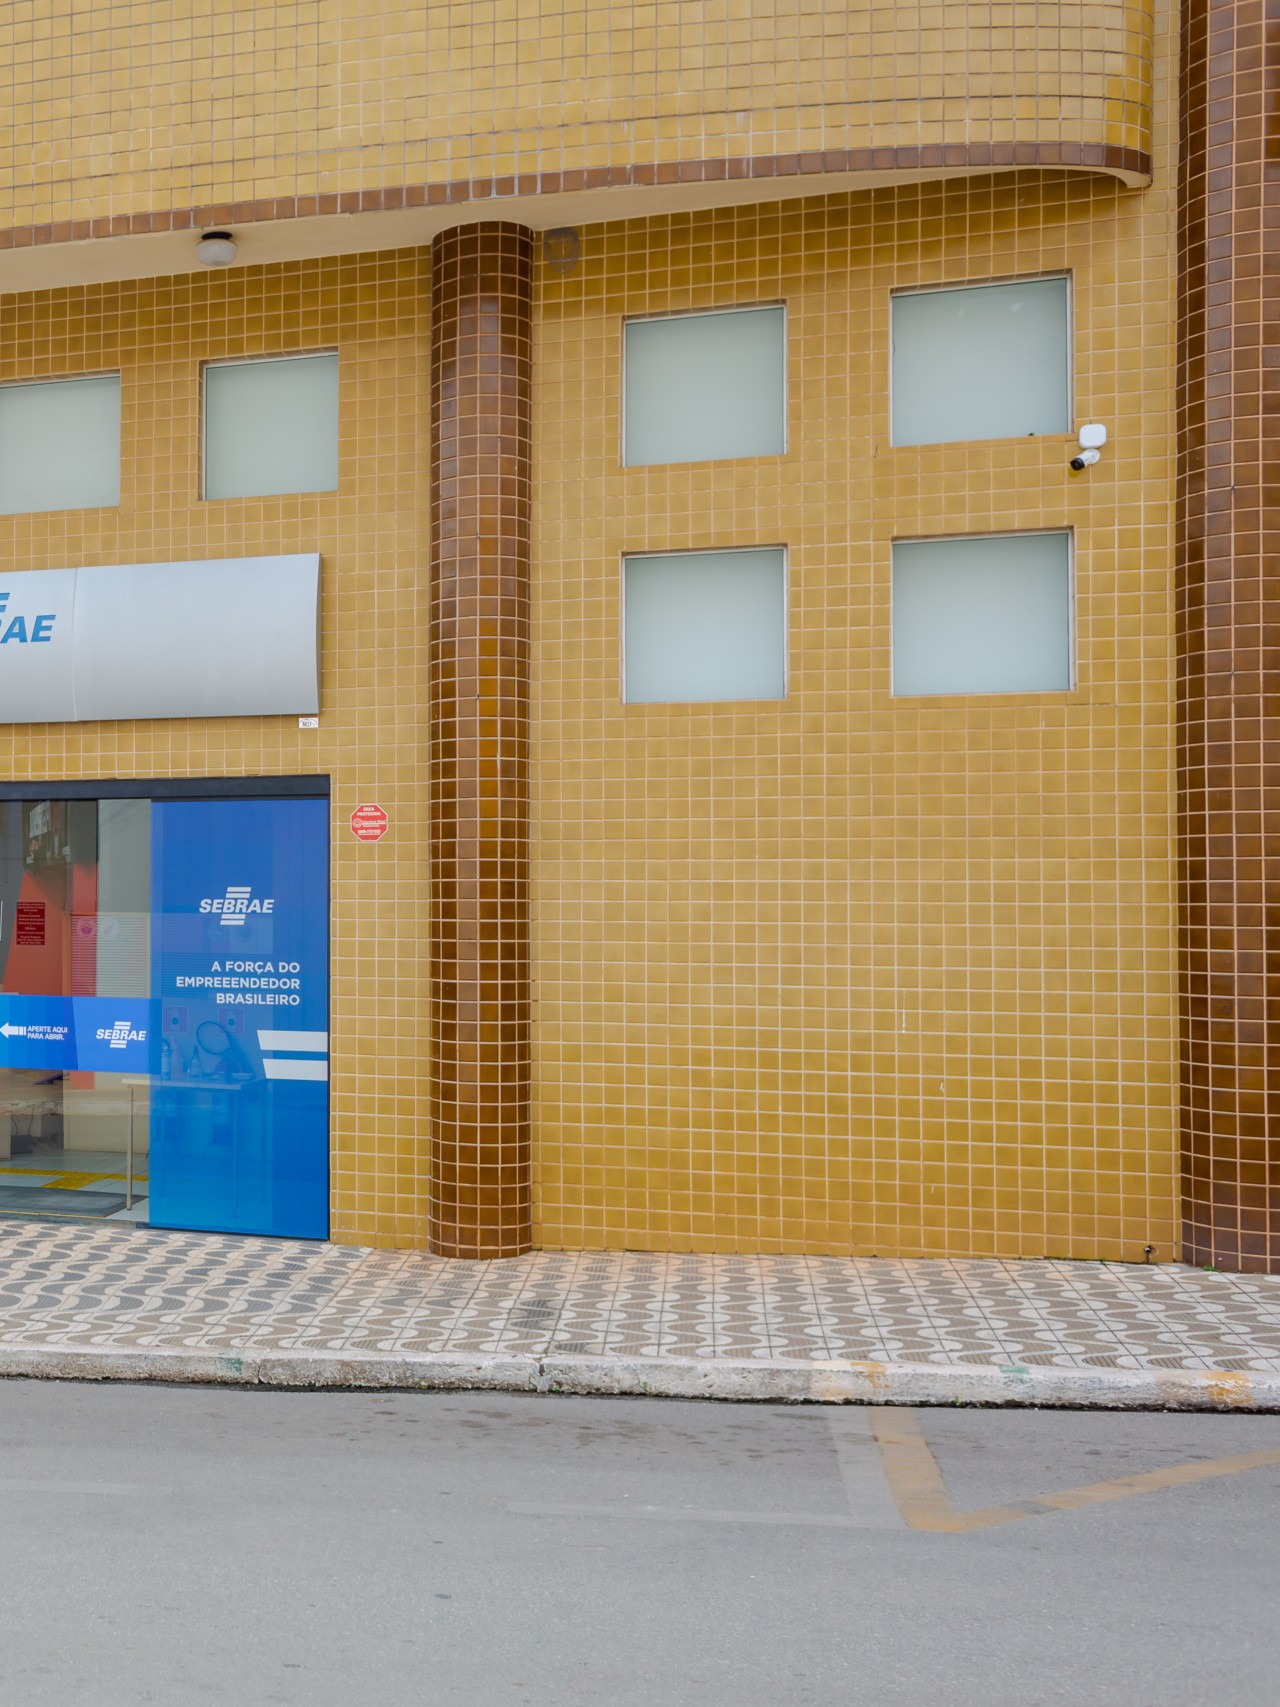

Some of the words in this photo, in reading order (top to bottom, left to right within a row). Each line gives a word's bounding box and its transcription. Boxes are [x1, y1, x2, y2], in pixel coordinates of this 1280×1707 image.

[199, 899, 275, 913] SEBRAE
[211, 961, 221, 972] A
[225, 961, 274, 974] FORÇA
[278, 962, 300, 973] DO
[176, 976, 300, 990] EMPREEENDEDOR
[216, 993, 300, 1006] BRASILEIRO
[27, 1025, 51, 1033] APERTE
[52, 1026, 68, 1034] AQUI
[96, 1029, 147, 1041] SEBRAE
